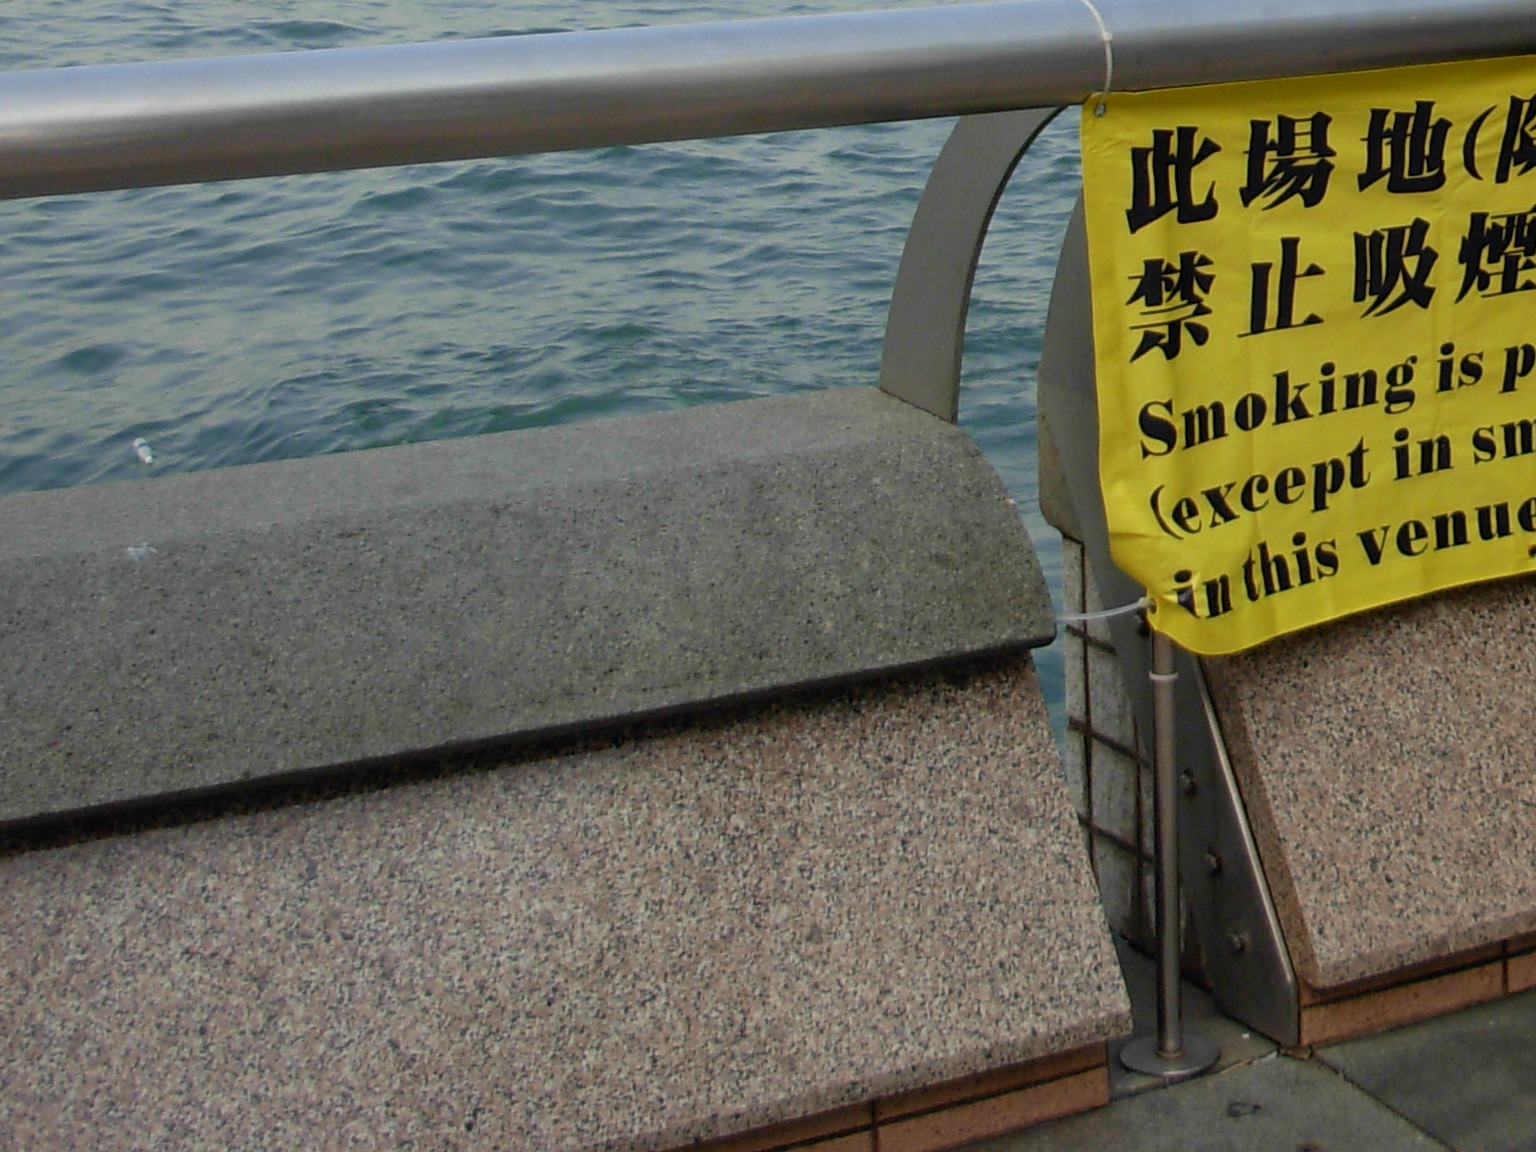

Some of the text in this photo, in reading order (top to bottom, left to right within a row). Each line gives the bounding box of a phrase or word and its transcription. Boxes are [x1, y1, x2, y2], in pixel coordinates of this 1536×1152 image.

[1138, 354, 1419, 460] Smoking
[1436, 342, 1485, 393] is
[1150, 435, 1373, 540] (except
[1392, 428, 1455, 481] in
[1171, 568, 1234, 620] in
[1242, 532, 1341, 604] this
